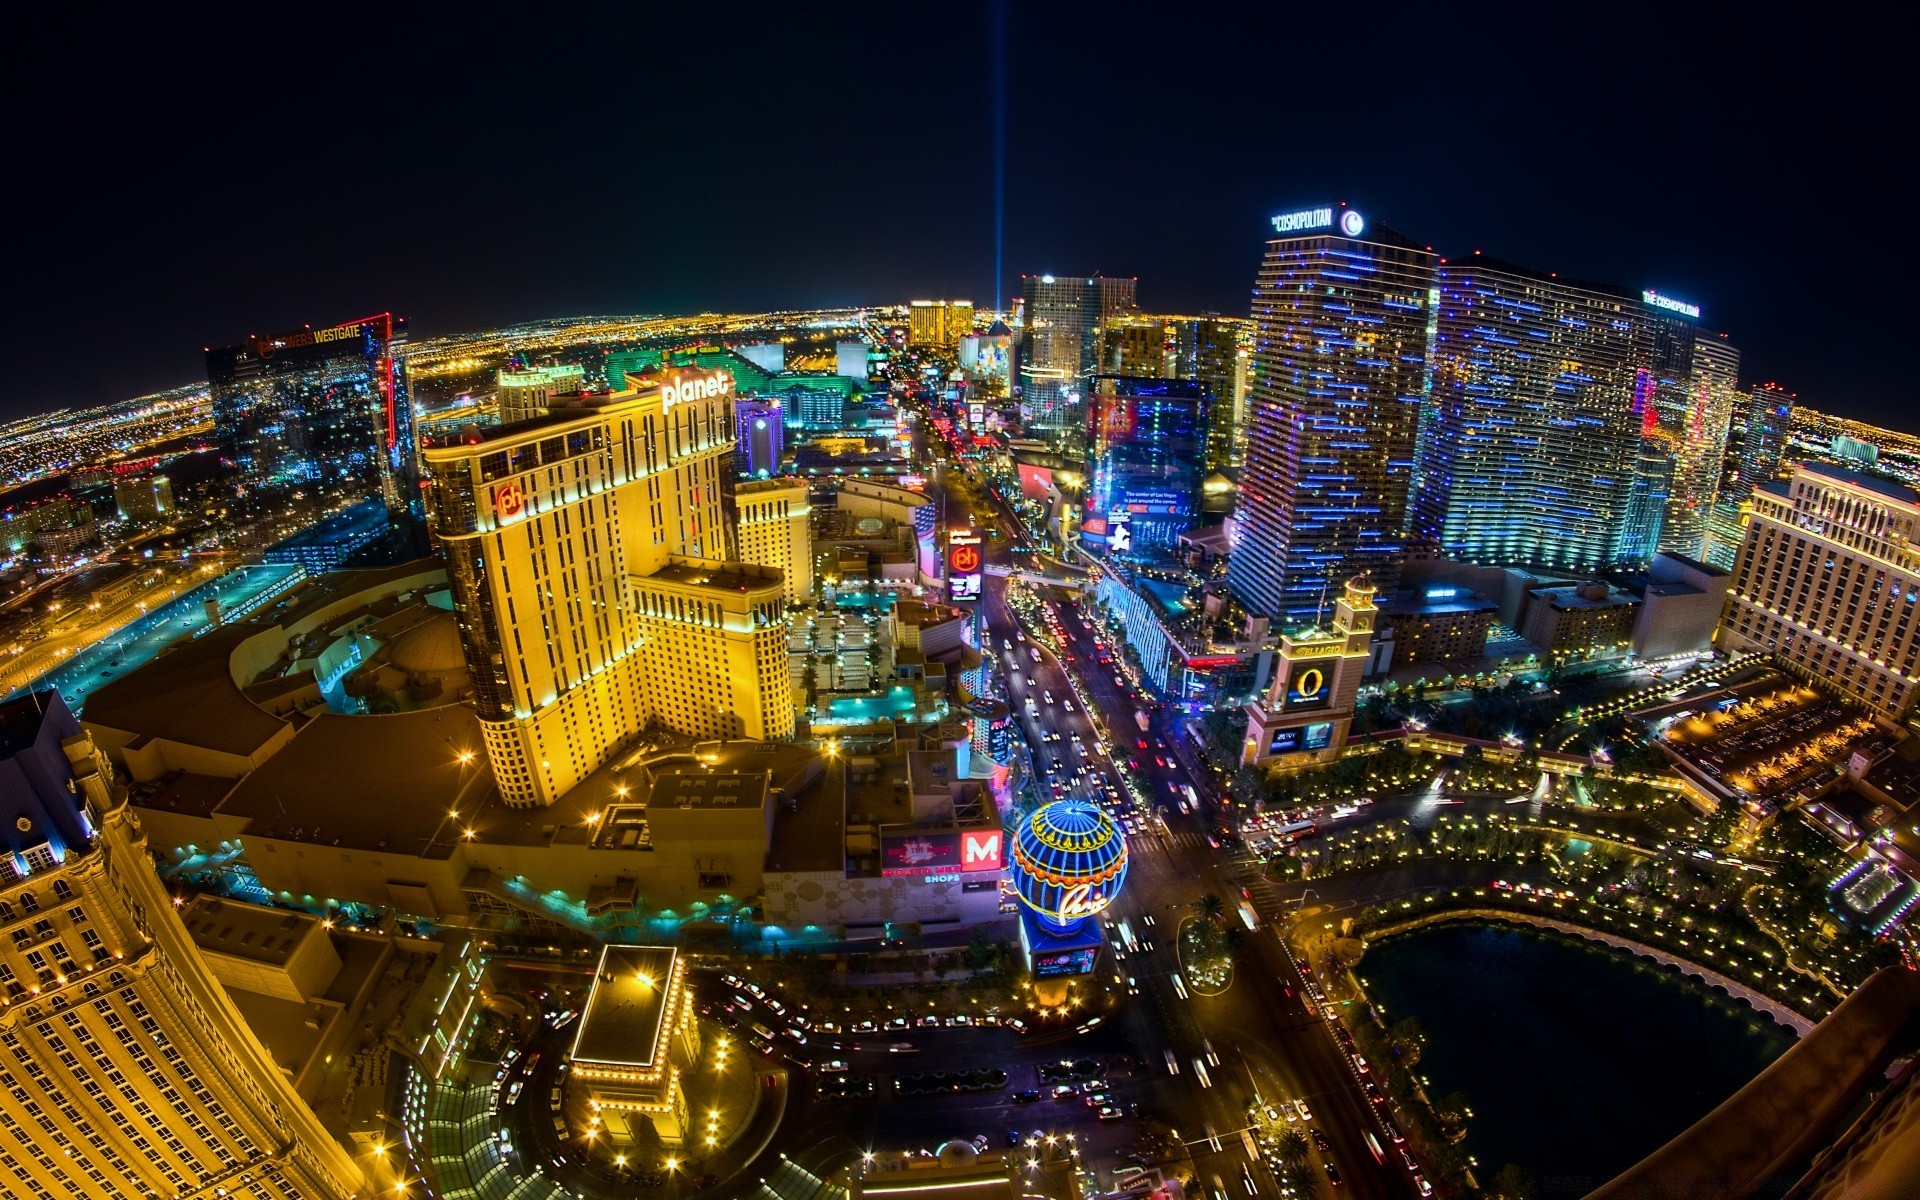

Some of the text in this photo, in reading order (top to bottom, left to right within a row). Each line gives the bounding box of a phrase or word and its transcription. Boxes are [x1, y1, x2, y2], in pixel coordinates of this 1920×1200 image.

[1276, 208, 1331, 232] COSMOPOLITAN
[1642, 290, 1700, 318] THE COSMOPOLITAN
[313, 324, 361, 343] WESTGATE
[662, 371, 729, 415] planet
[967, 835, 999, 863] M
[924, 874, 960, 884] SHOPS
[1059, 883, 1108, 926] Paris
